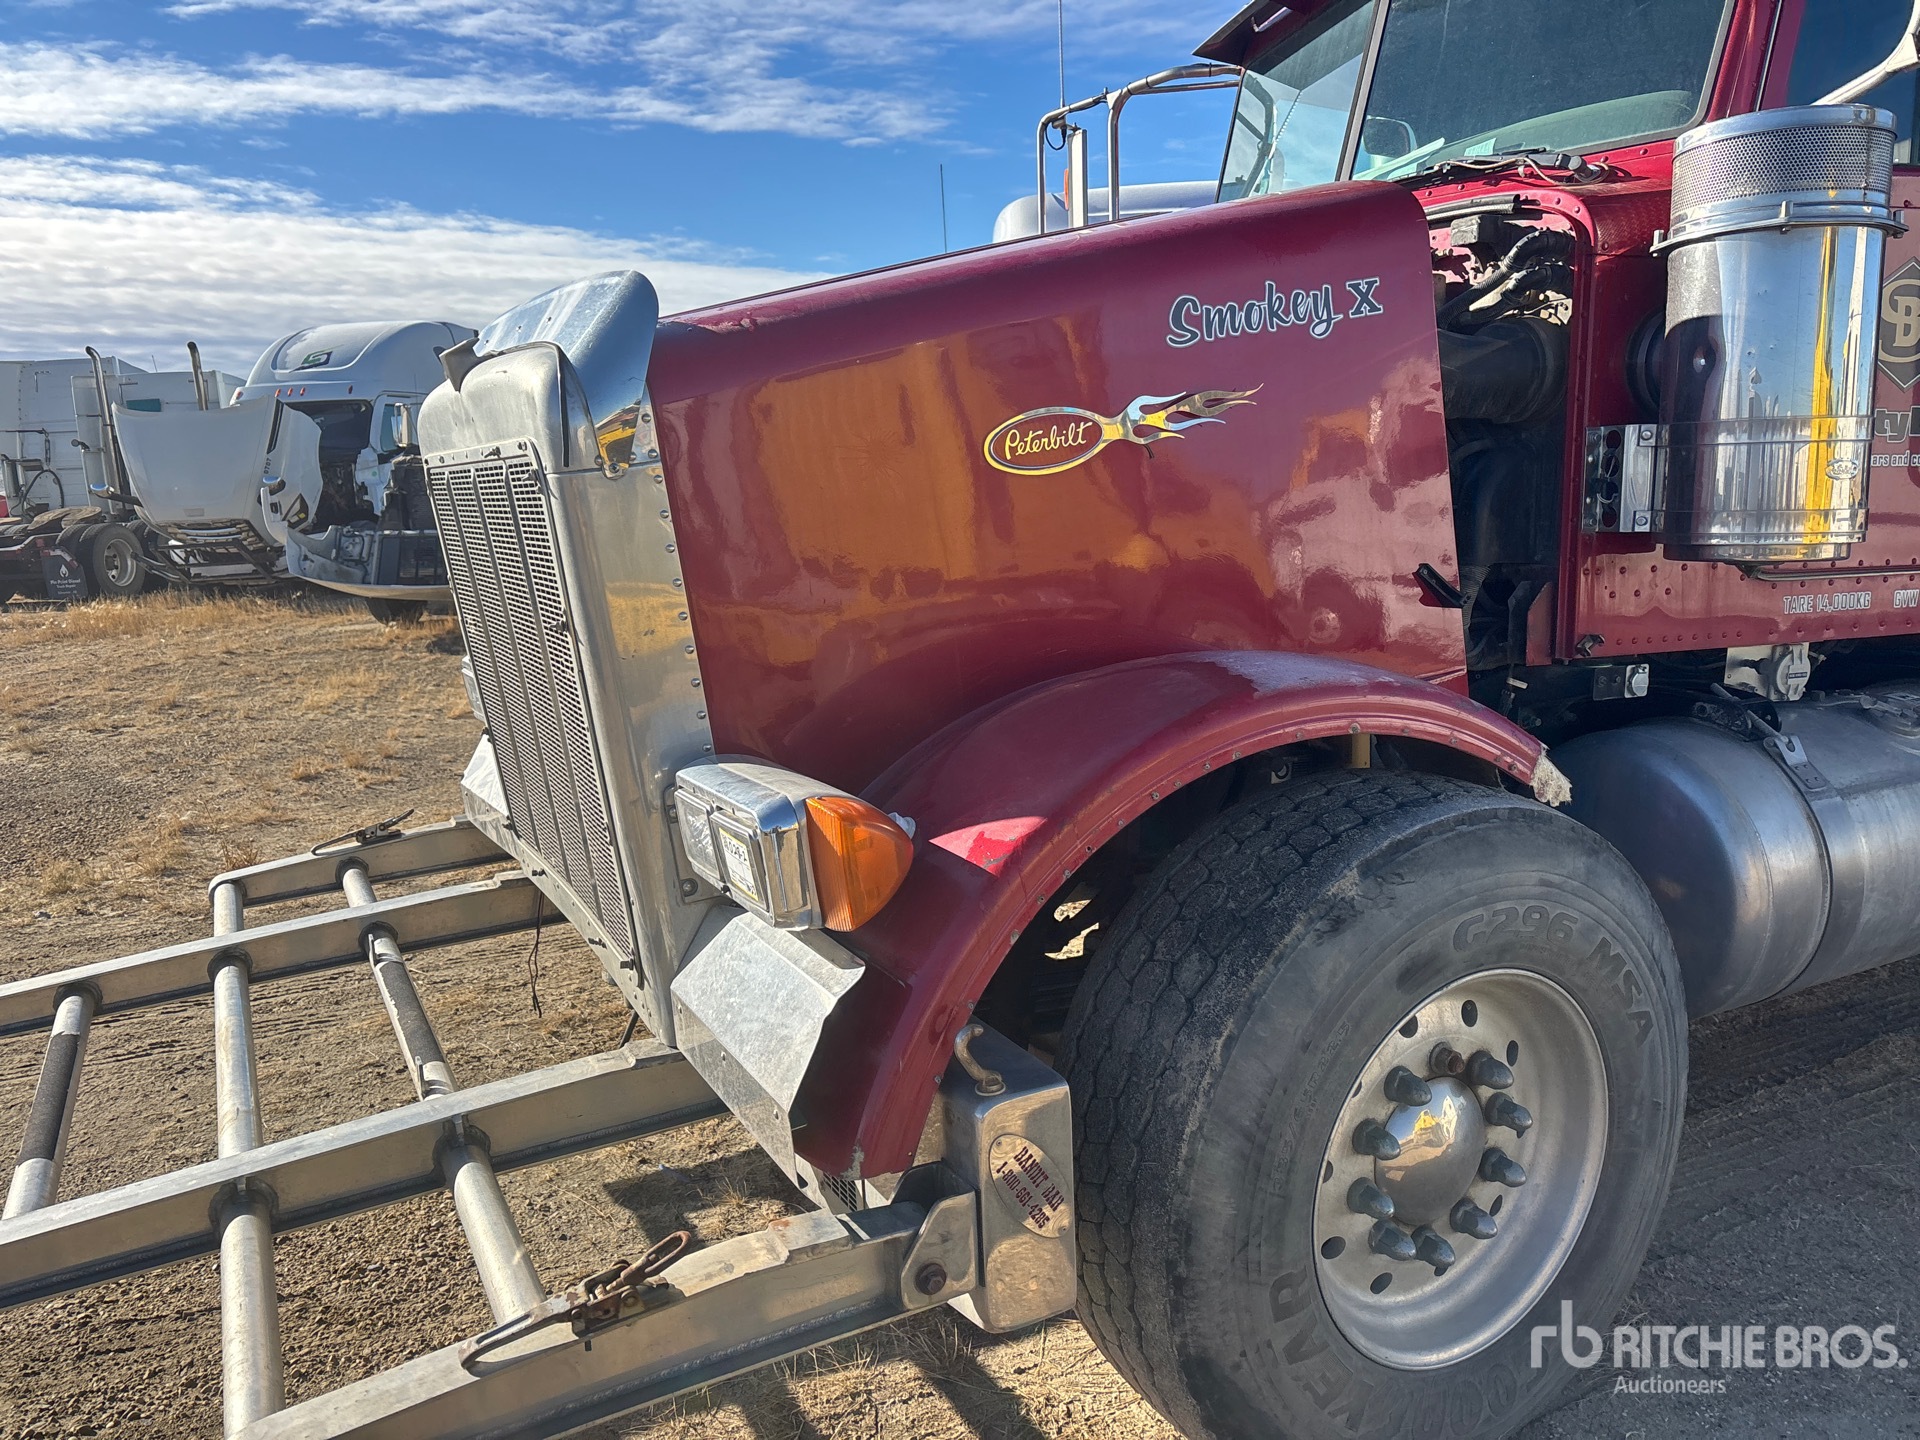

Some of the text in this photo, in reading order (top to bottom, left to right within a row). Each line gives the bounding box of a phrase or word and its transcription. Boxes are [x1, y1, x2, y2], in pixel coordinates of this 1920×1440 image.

[1166, 277, 1383, 348] Smokey X
[1004, 420, 1093, 460] Peterbilt
[1891, 449, 1910, 466] and
[1783, 591, 1871, 614] TARE 14,000KG
[1893, 589, 1919, 608] GVW
[1587, 936, 1654, 1048] MSA
[995, 1161, 1051, 1229] 1-800-661-4285
[1013, 1146, 1065, 1212] BANDIT BAR
